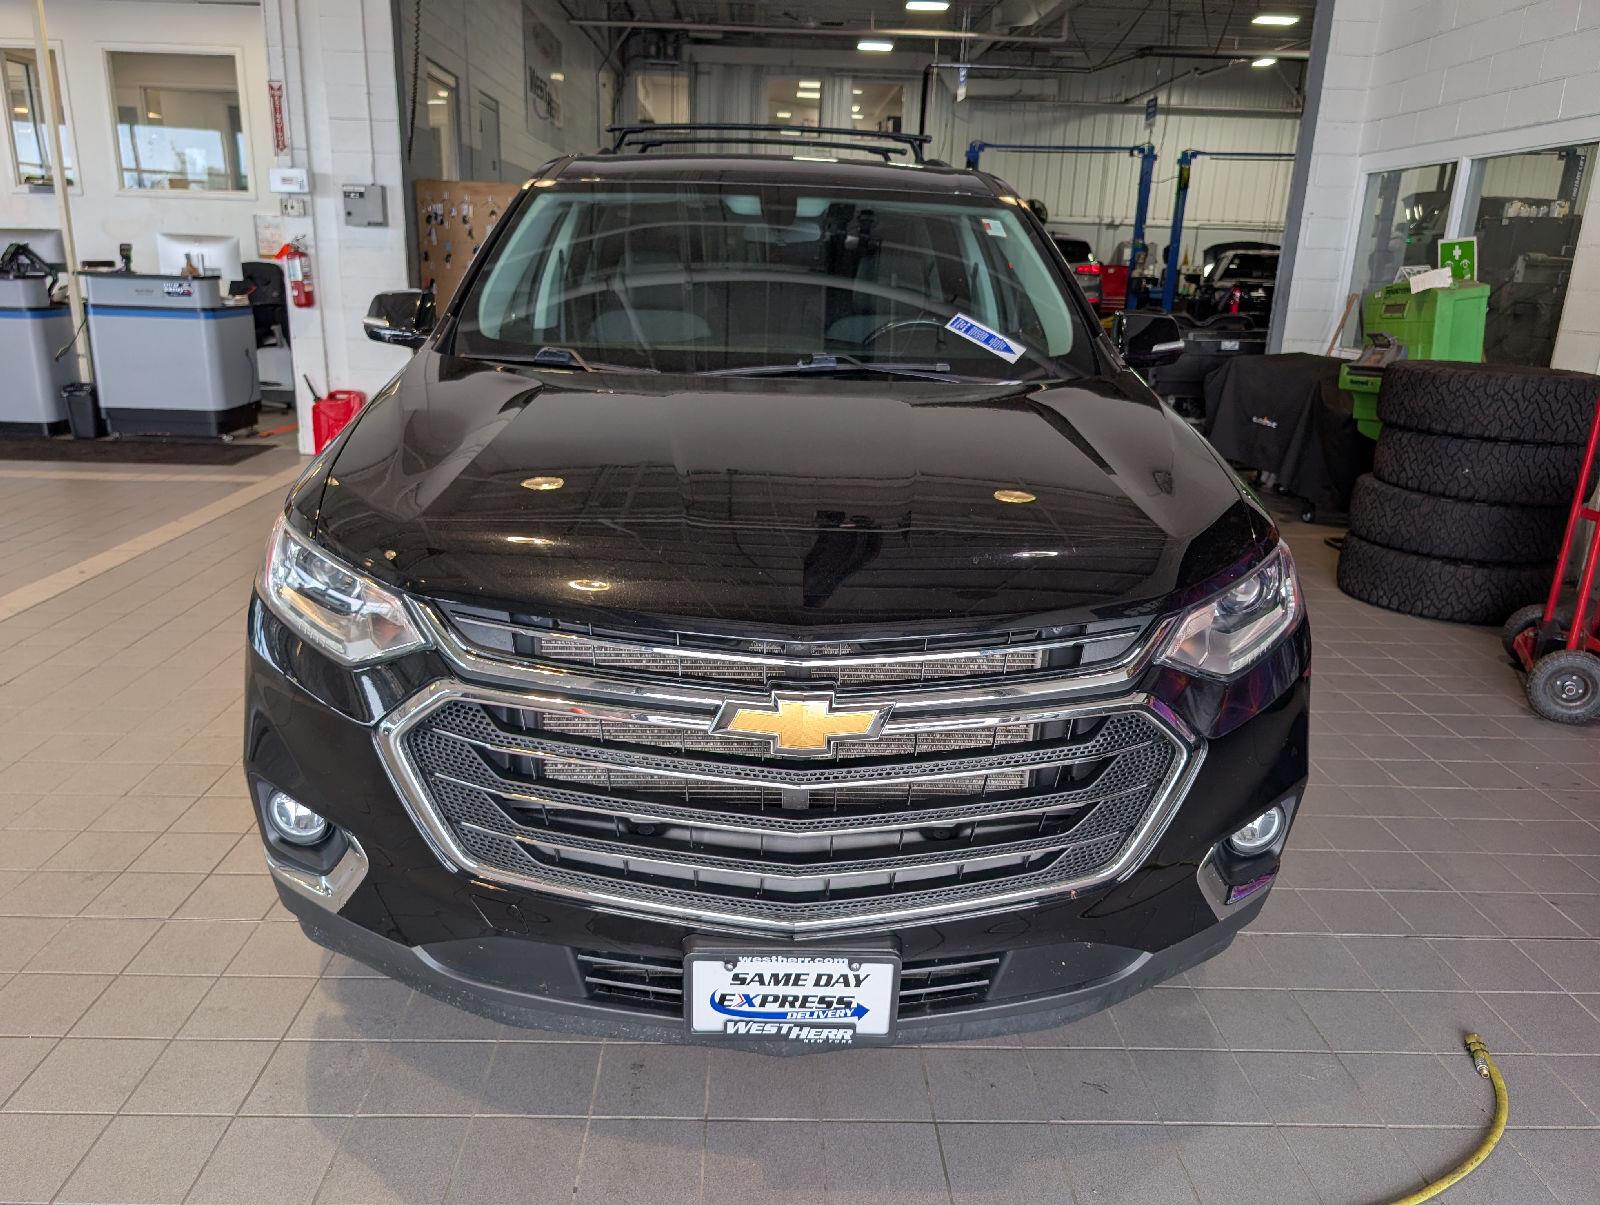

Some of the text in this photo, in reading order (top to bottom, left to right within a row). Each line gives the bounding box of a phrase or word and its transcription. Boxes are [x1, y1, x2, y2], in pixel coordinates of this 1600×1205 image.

[738, 955, 848, 965] westherr.com
[730, 972, 871, 988] SAME DAY
[717, 993, 855, 1009] EXPRESS
[786, 1008, 855, 1020] DELIVERY
